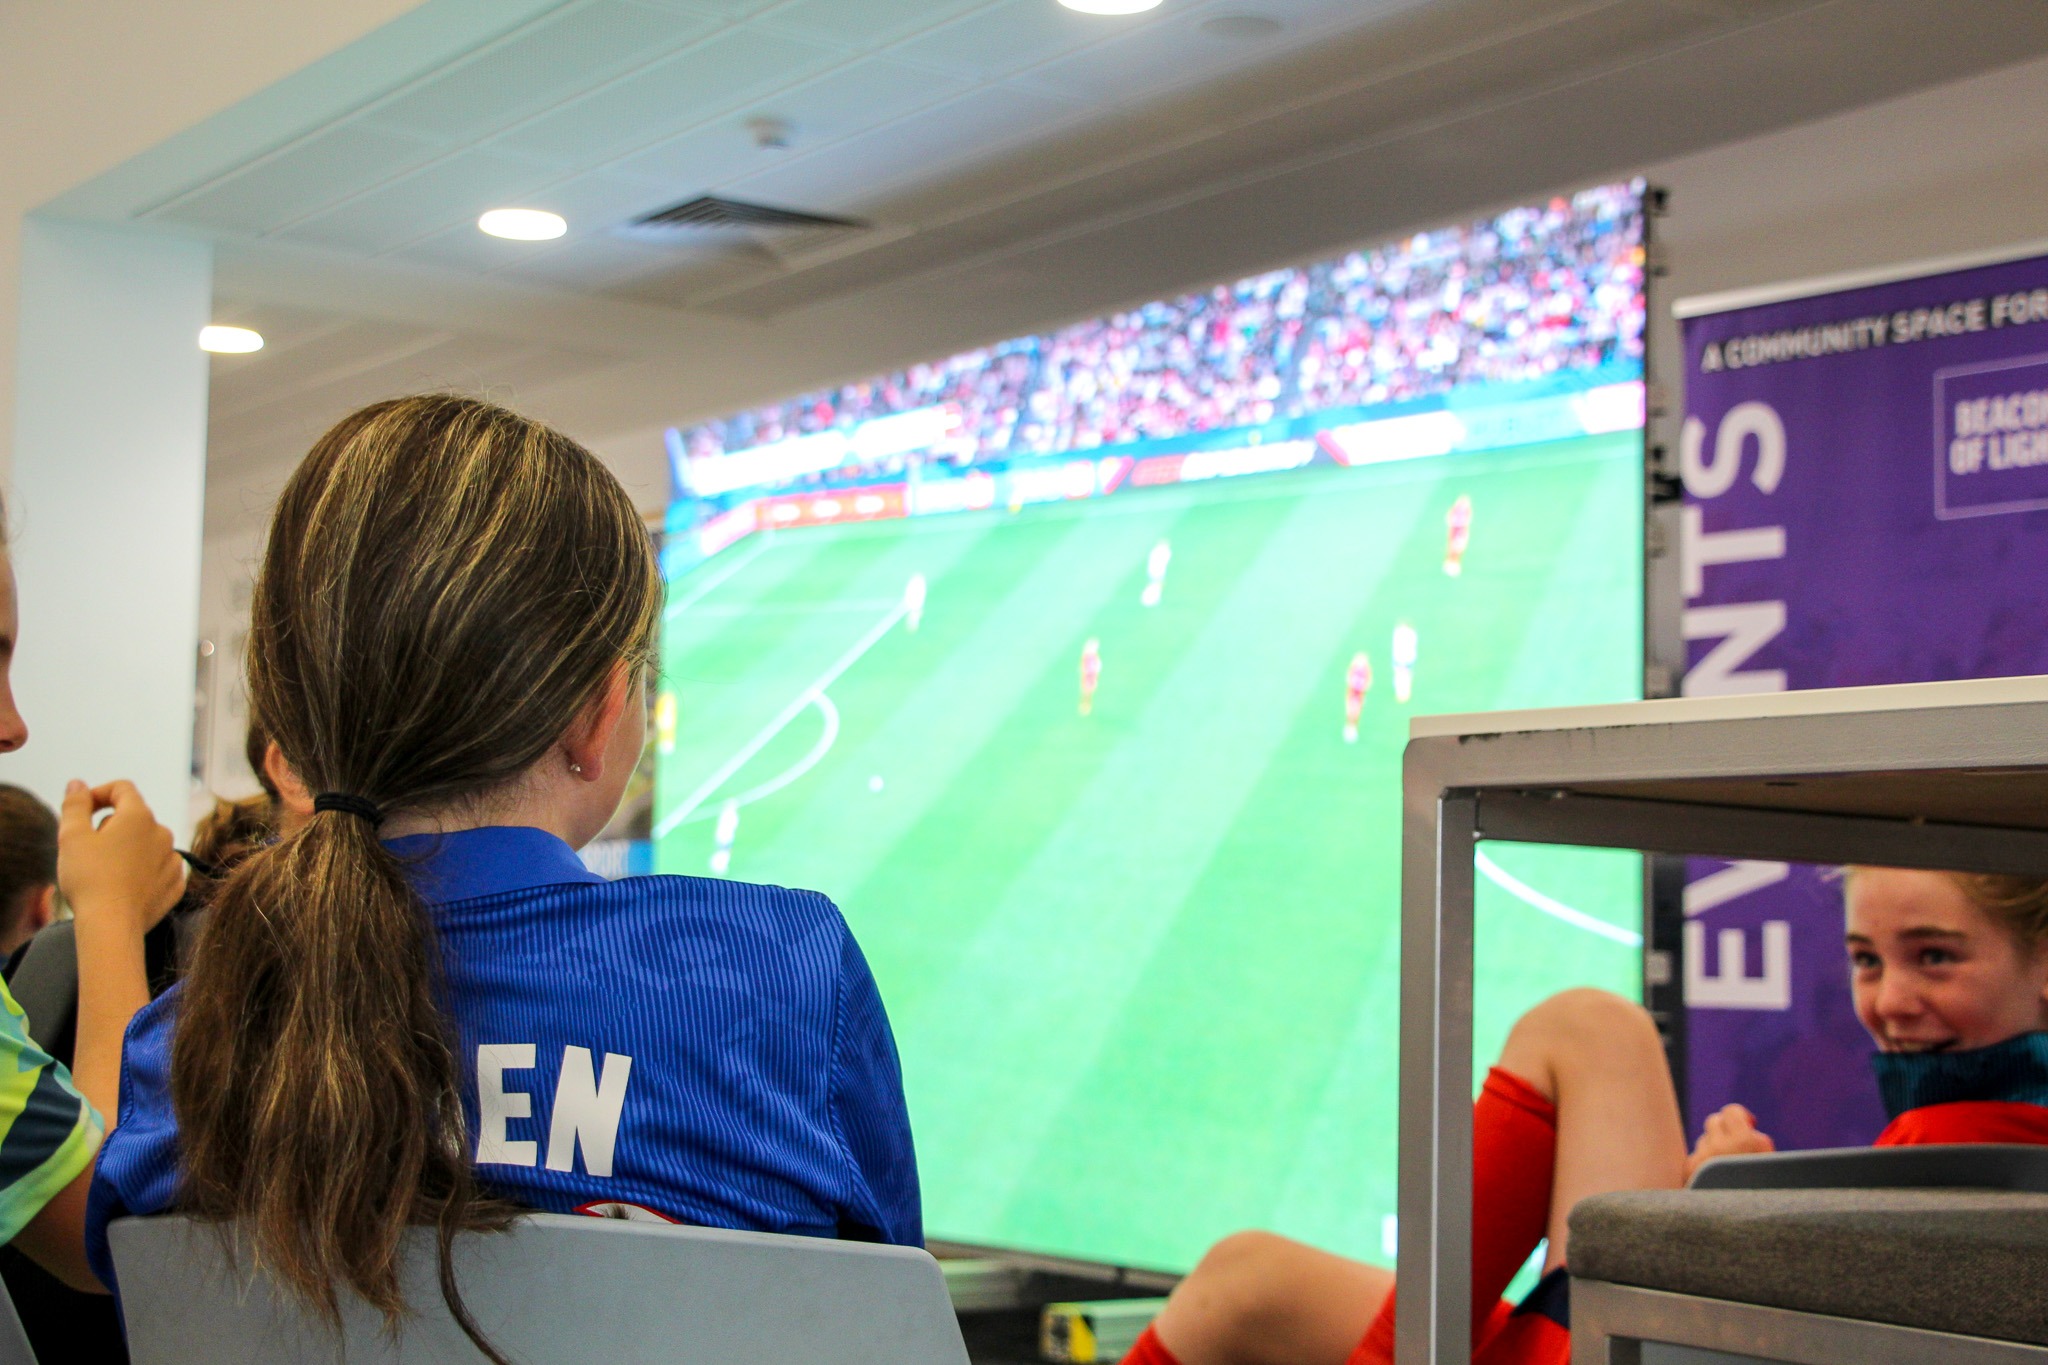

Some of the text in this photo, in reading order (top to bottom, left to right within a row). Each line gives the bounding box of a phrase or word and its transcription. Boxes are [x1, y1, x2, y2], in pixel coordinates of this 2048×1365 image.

[1701, 340, 1725, 374] A
[1725, 317, 1888, 369] COMMUNITY
[1891, 298, 1987, 344] SPACE
[1949, 437, 1983, 475] OF
[1681, 400, 1792, 1012] EVNTS
[475, 1043, 633, 1178] EN
